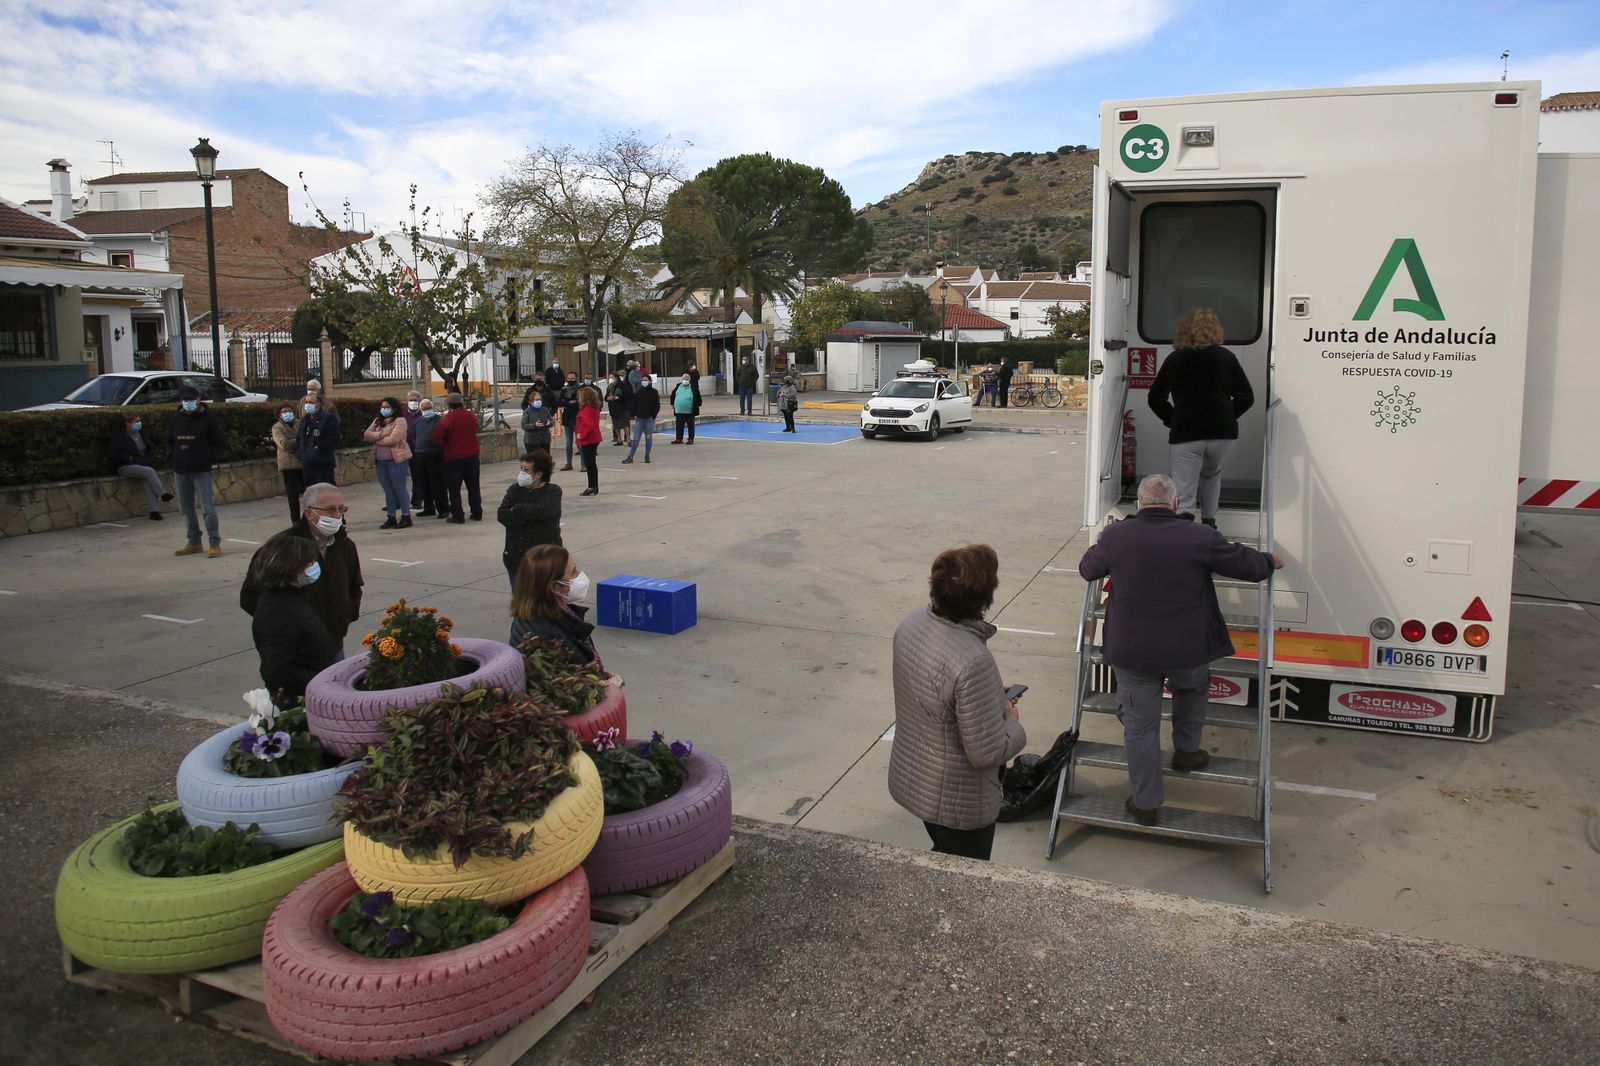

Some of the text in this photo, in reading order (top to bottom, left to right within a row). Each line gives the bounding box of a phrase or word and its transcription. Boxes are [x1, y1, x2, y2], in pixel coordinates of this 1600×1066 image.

[1125, 137, 1164, 160] C3
[1303, 326, 1497, 345] Junta de Andalucía
[1321, 350, 1477, 363] Consejería de Salud y Familias
[1342, 367, 1453, 378] RESPUESTA COVID-19
[1393, 651, 1475, 671] 0866 DVP
[1350, 704, 1434, 717] CARROCEROS
